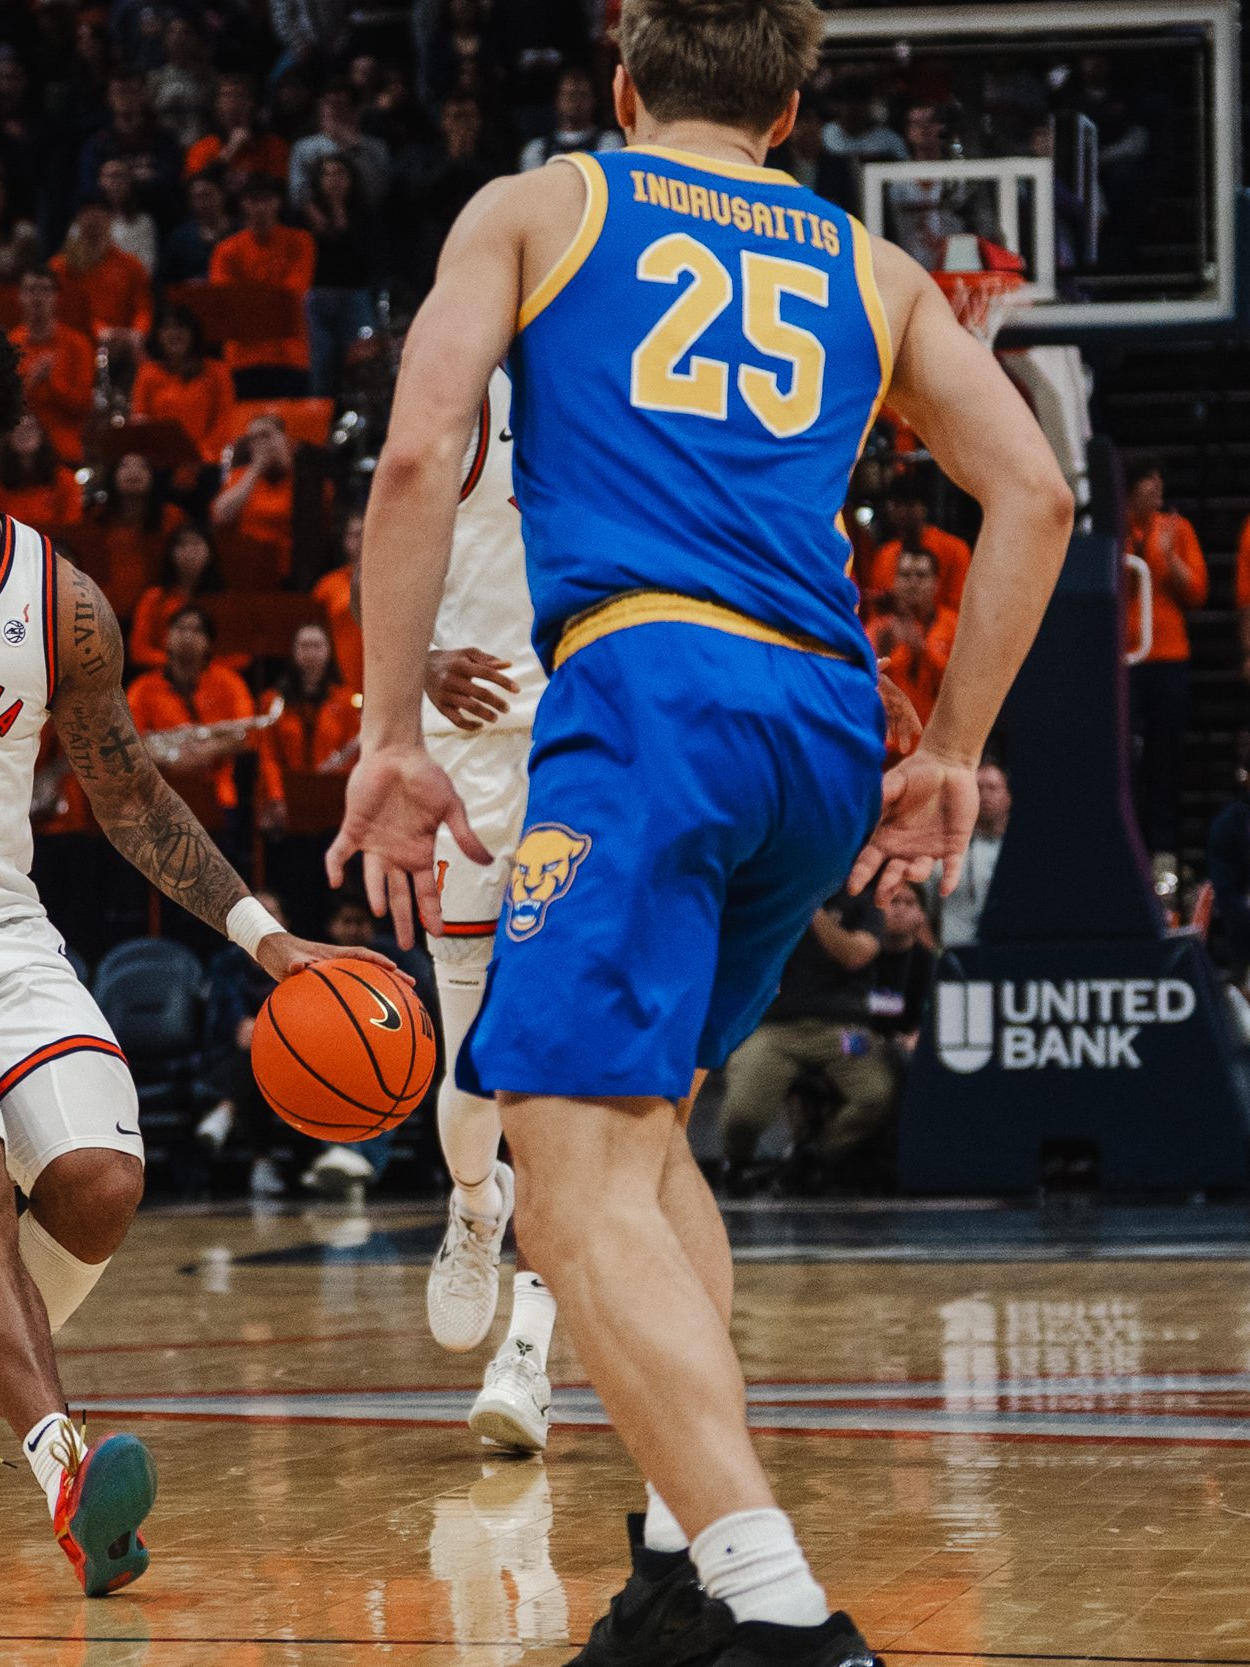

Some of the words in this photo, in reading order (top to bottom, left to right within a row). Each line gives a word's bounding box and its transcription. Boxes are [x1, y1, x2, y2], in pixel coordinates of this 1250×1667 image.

[630, 170, 841, 256] INDRUSAITIS
[630, 232, 829, 438] 25
[1002, 979, 1196, 1023] UNITED
[1003, 1025, 1142, 1069] BANK
